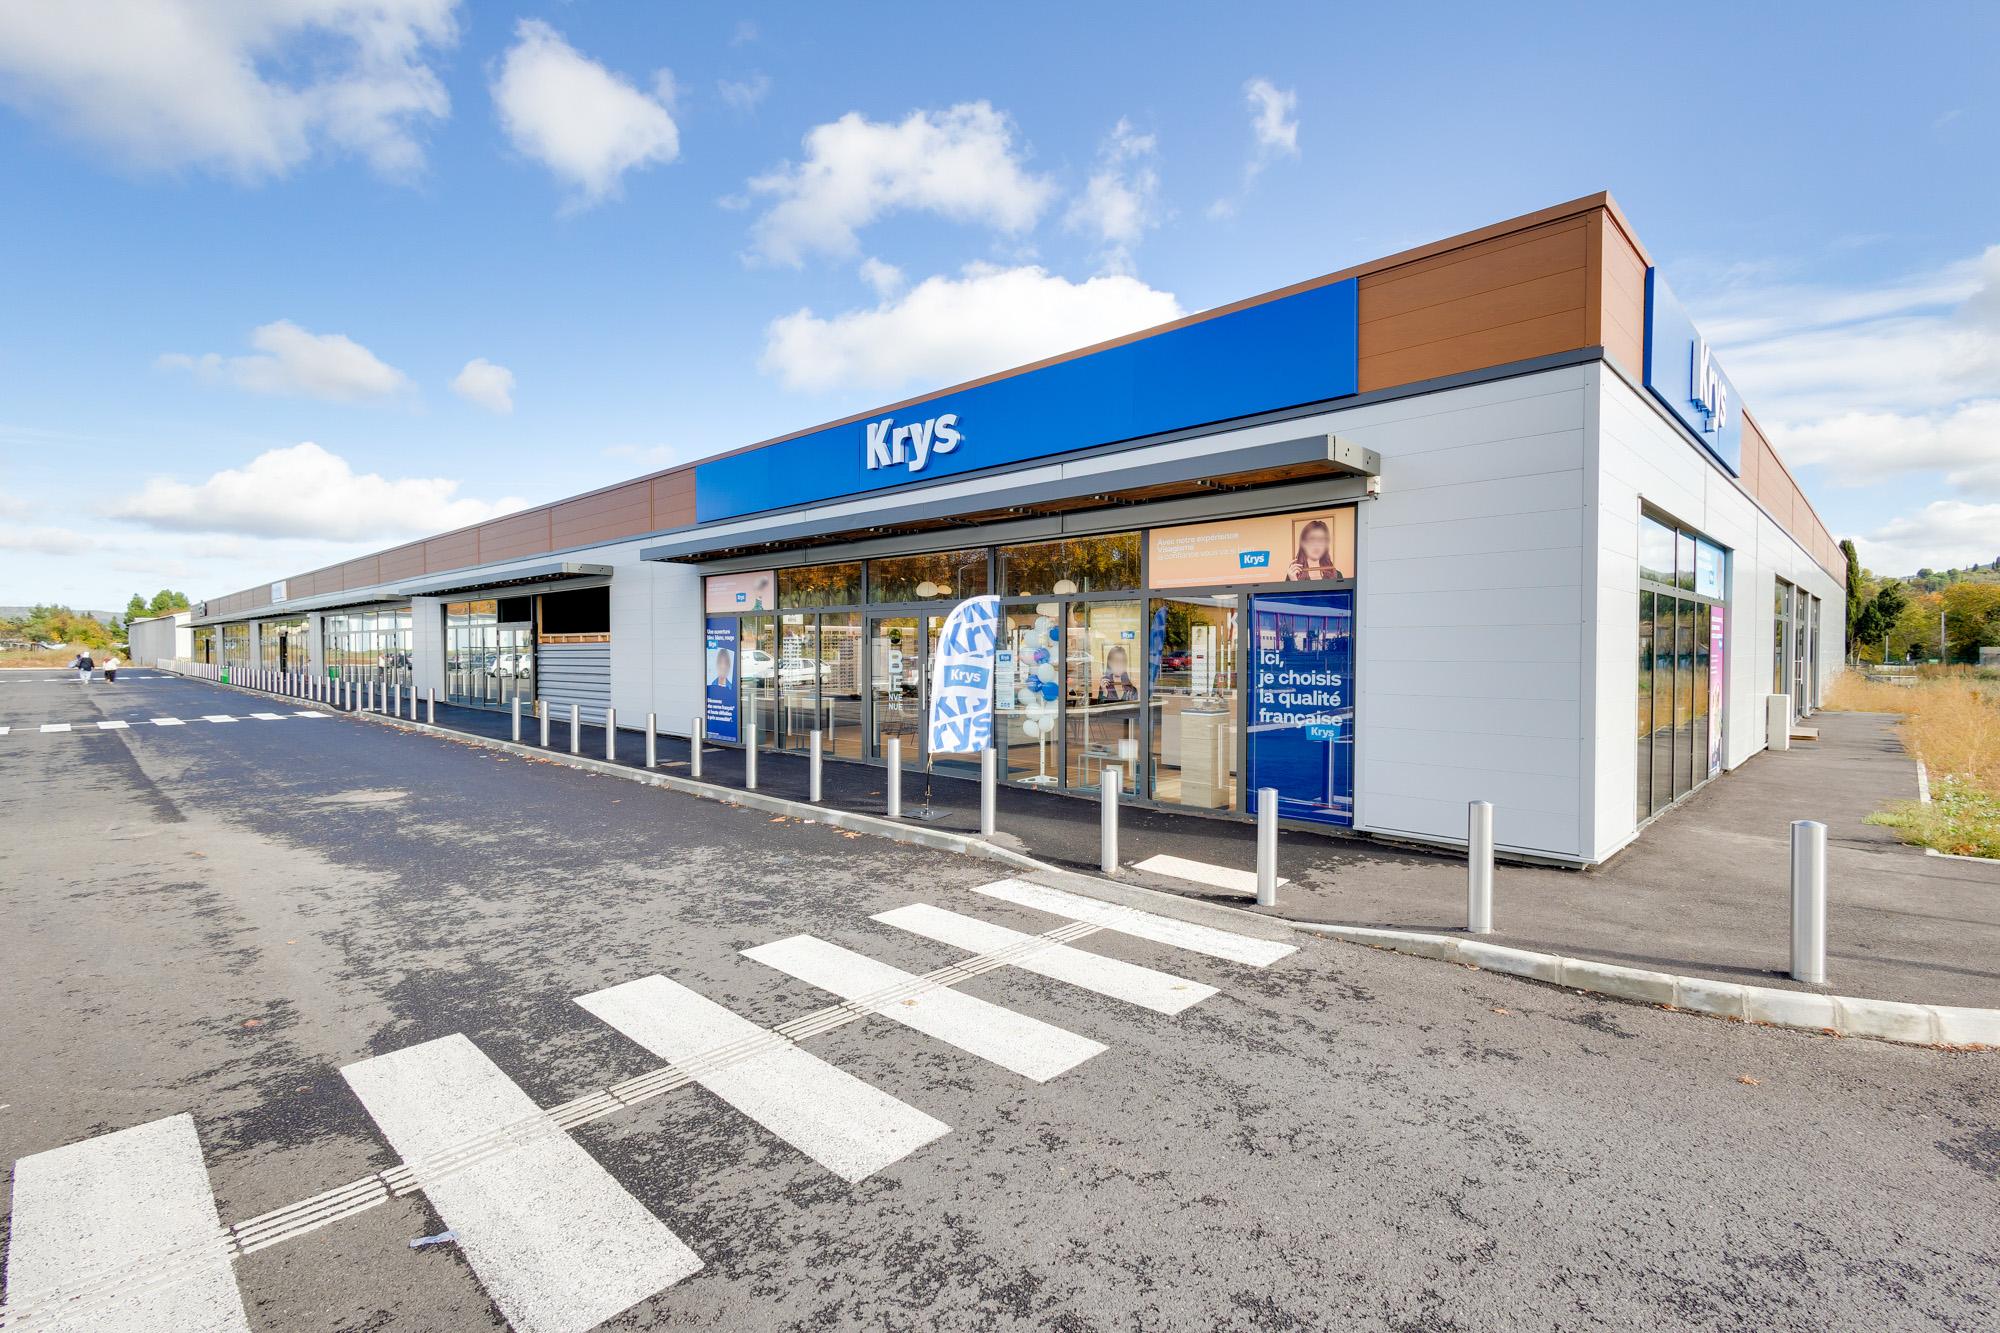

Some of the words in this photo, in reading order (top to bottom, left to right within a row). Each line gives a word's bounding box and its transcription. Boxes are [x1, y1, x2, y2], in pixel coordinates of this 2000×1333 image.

[1699, 338, 1727, 433] Krys
[866, 413, 961, 472] Krys
[1244, 553, 1265, 565] Krys
[1260, 649, 1284, 668] Ici,
[950, 668, 981, 684] Krys
[1257, 669, 1275, 687] je
[1278, 670, 1342, 686] choisis
[1259, 688, 1275, 704] la
[1278, 690, 1342, 708] qualité
[1258, 708, 1343, 728] française
[1311, 727, 1335, 737] Krys
